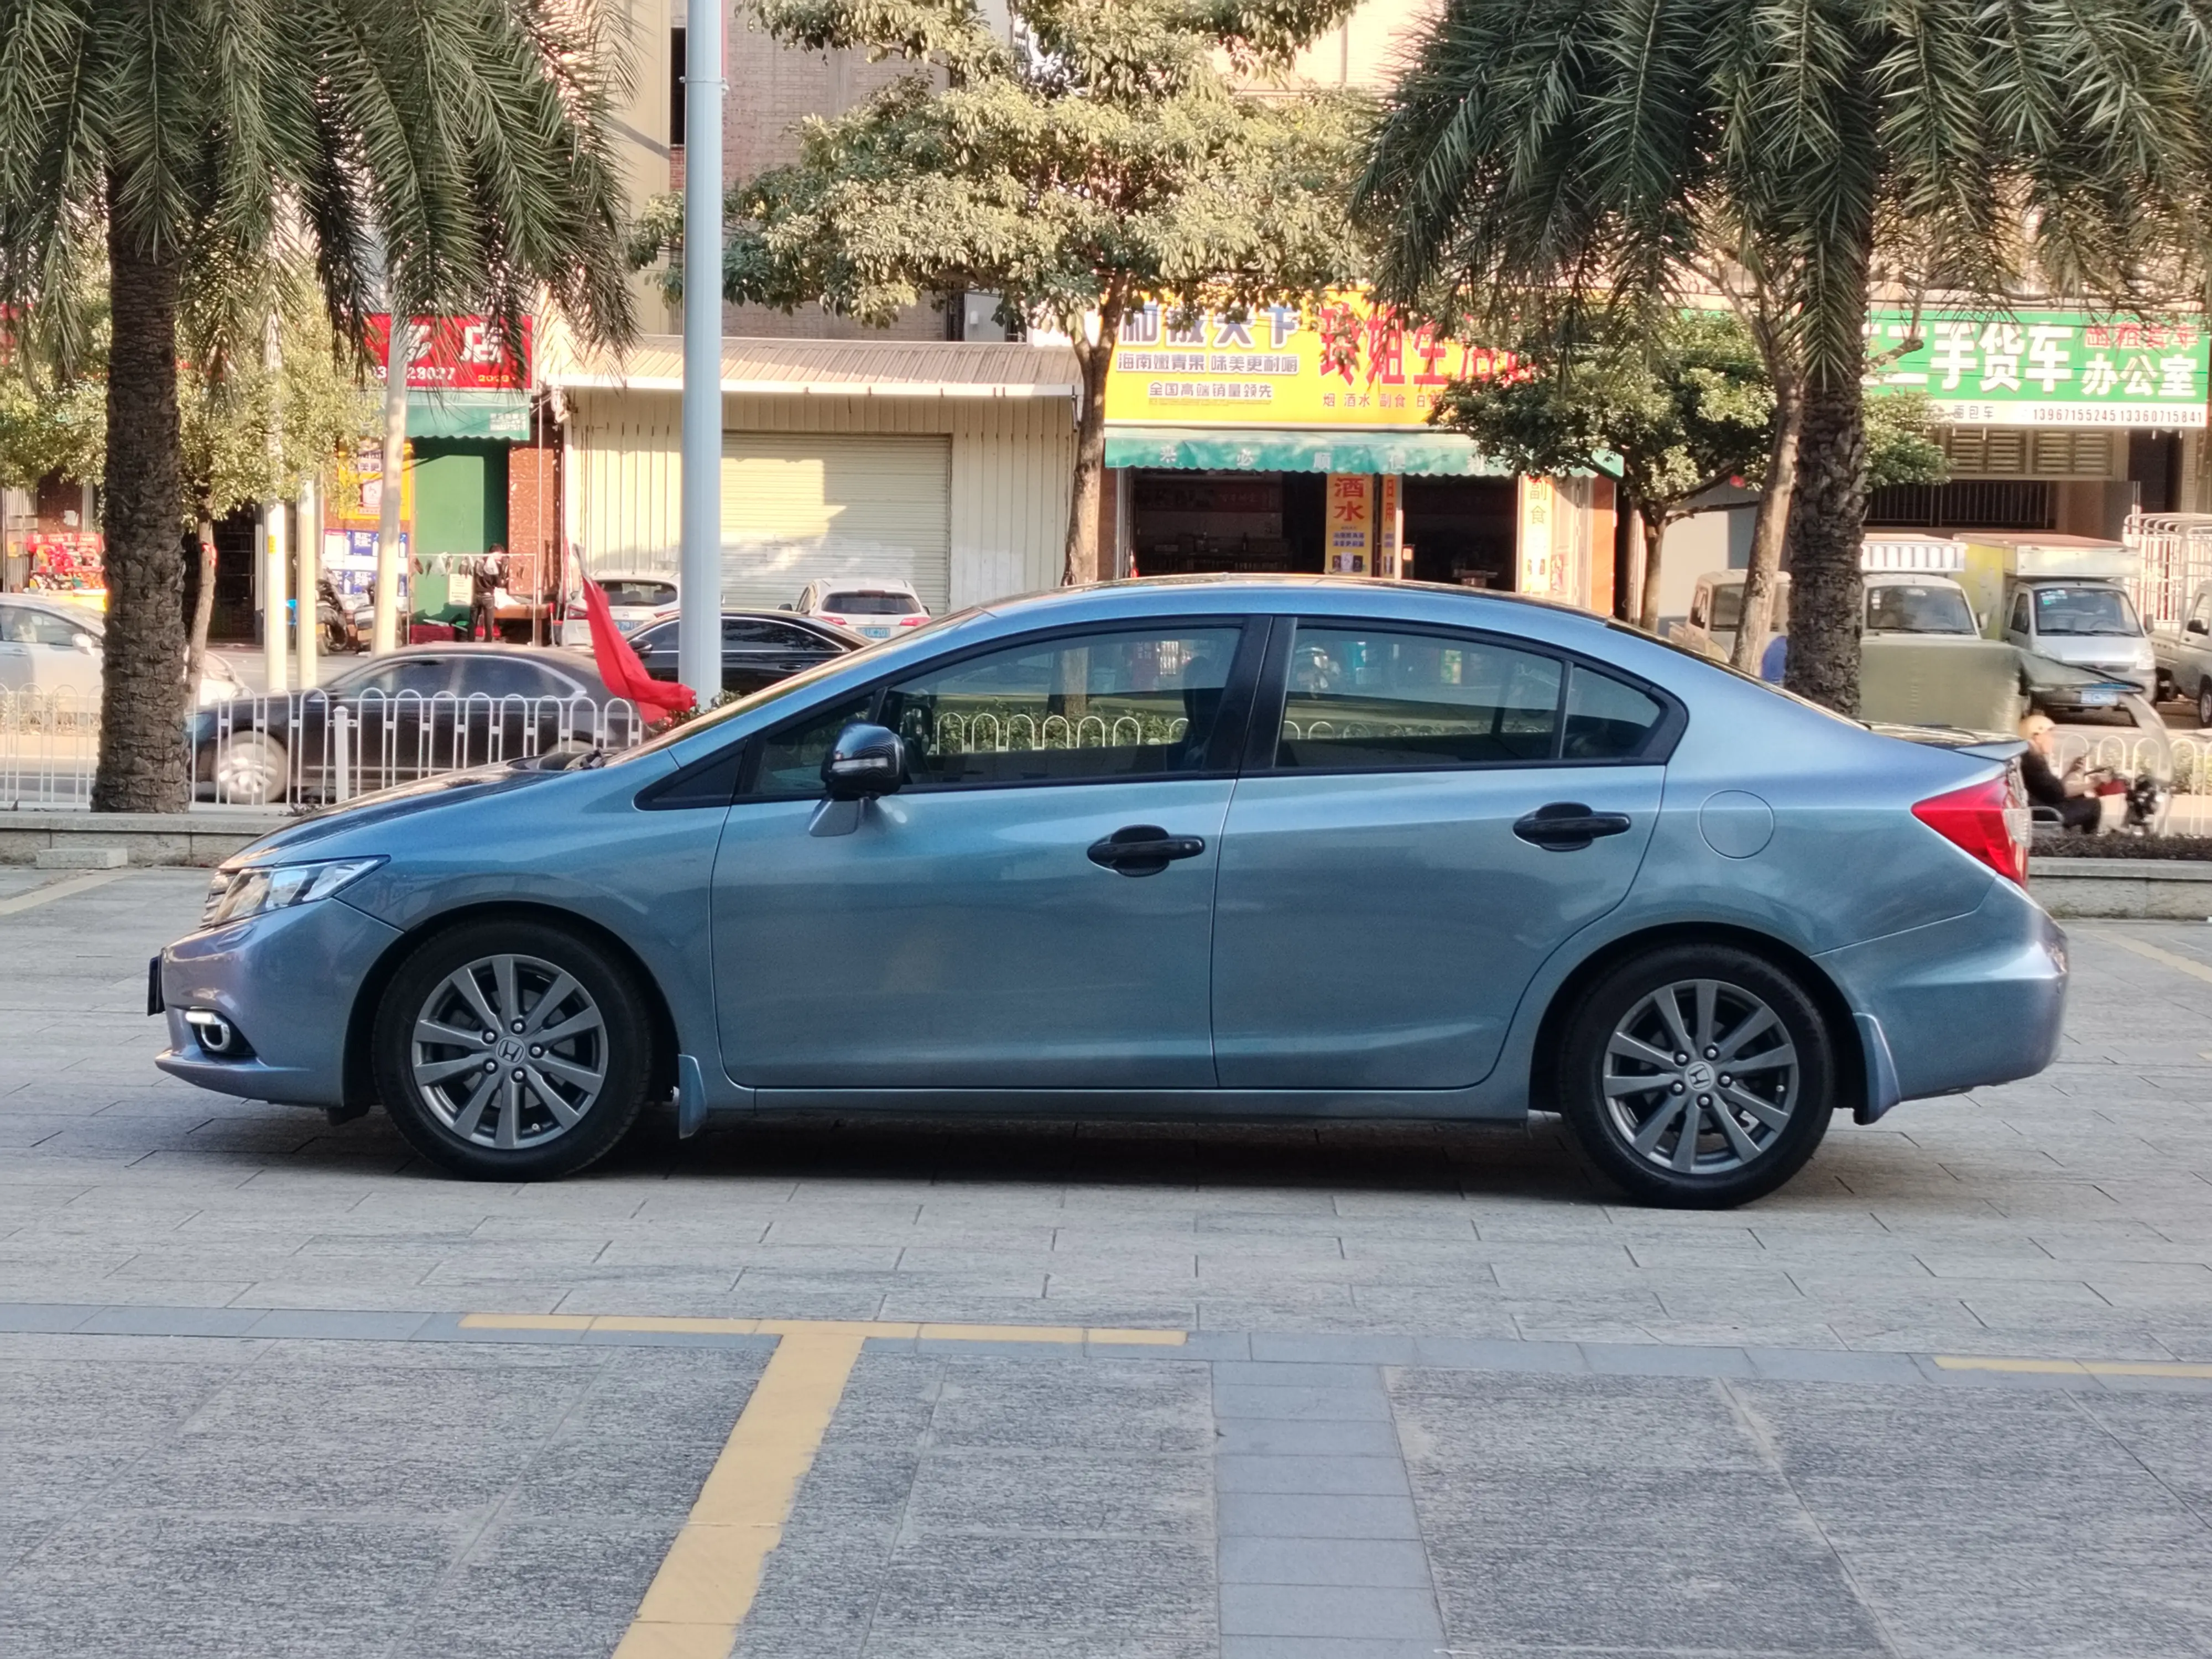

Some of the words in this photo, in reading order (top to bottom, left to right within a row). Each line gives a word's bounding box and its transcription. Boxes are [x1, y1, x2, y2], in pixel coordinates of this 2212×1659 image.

[1118, 352, 1205, 372] 海南嫩青果
[1211, 354, 1298, 374] 味美更耐嚼
[1861, 322, 2073, 392] 二手货车
[1149, 382, 1272, 398] 全国高端销量领先
[2080, 352, 2198, 396] 办公室
[1344, 393, 1370, 408] 酒水
[1380, 393, 1406, 408] 副食
[1953, 405, 1994, 419] 面包车
[1333, 477, 1365, 521] 酒水
[1530, 479, 1547, 525] 副食
